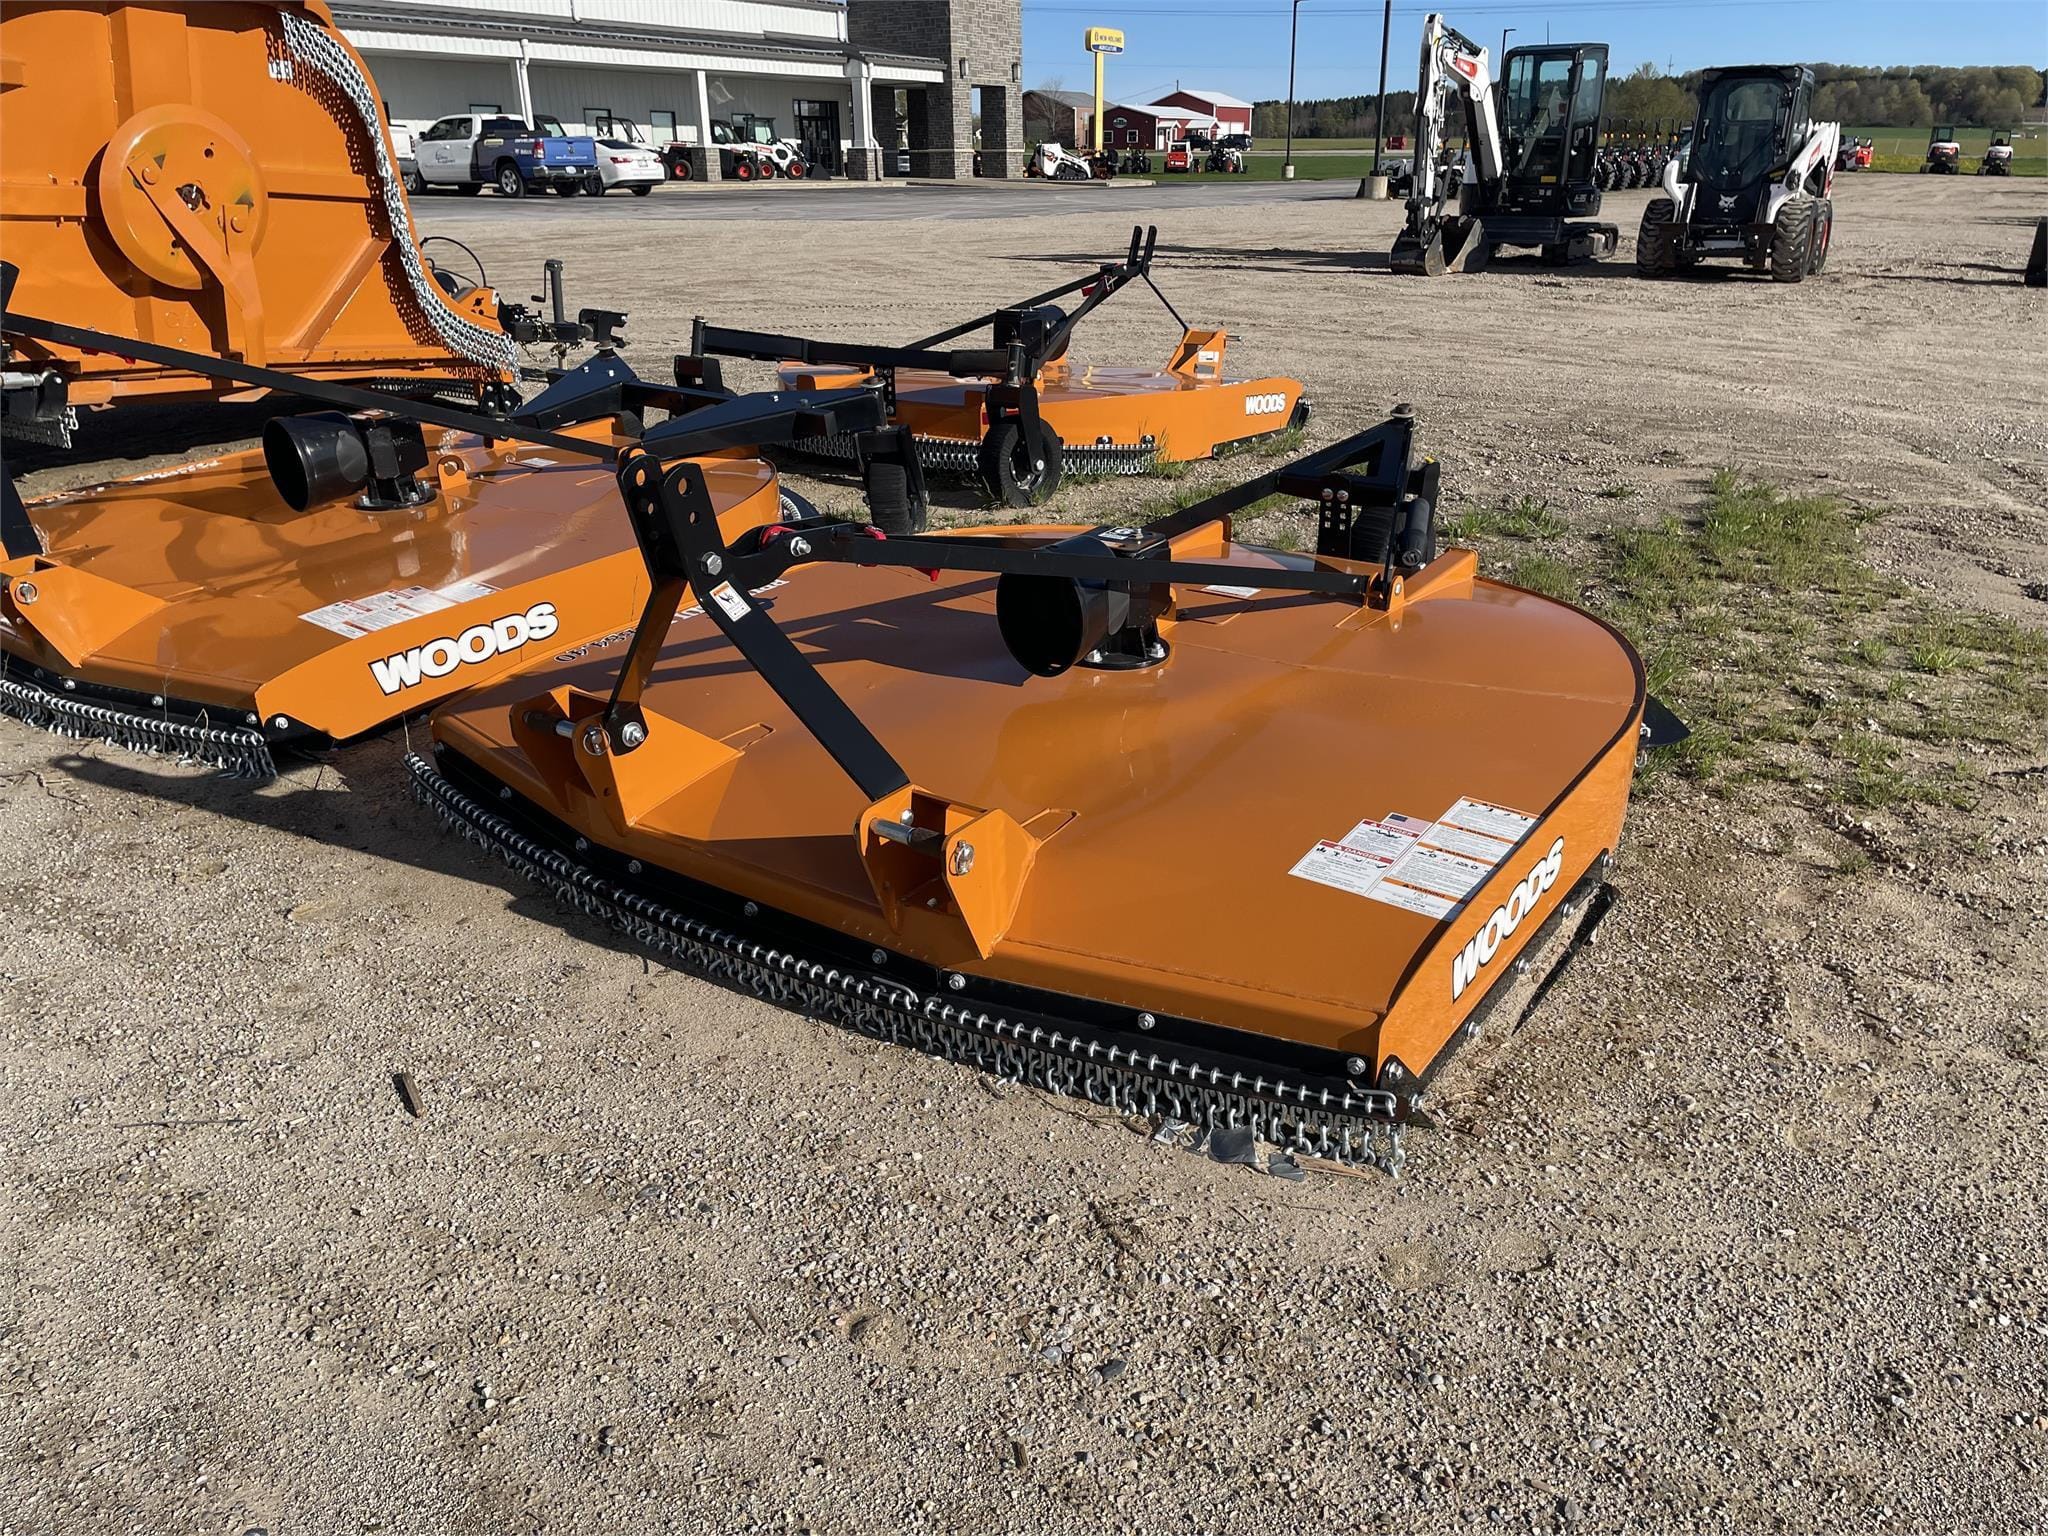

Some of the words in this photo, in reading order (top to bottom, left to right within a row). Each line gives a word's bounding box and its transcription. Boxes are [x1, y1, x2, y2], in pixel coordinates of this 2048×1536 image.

[1245, 392, 1286, 416] WOODS
[368, 602, 559, 696] WOODS
[1379, 824, 1414, 838] DANGER
[1343, 847, 1381, 861] DANGER
[1445, 849, 1478, 861] WARNING
[1411, 884, 1446, 899] WARNING
[1453, 836, 1564, 1004] WOODS
